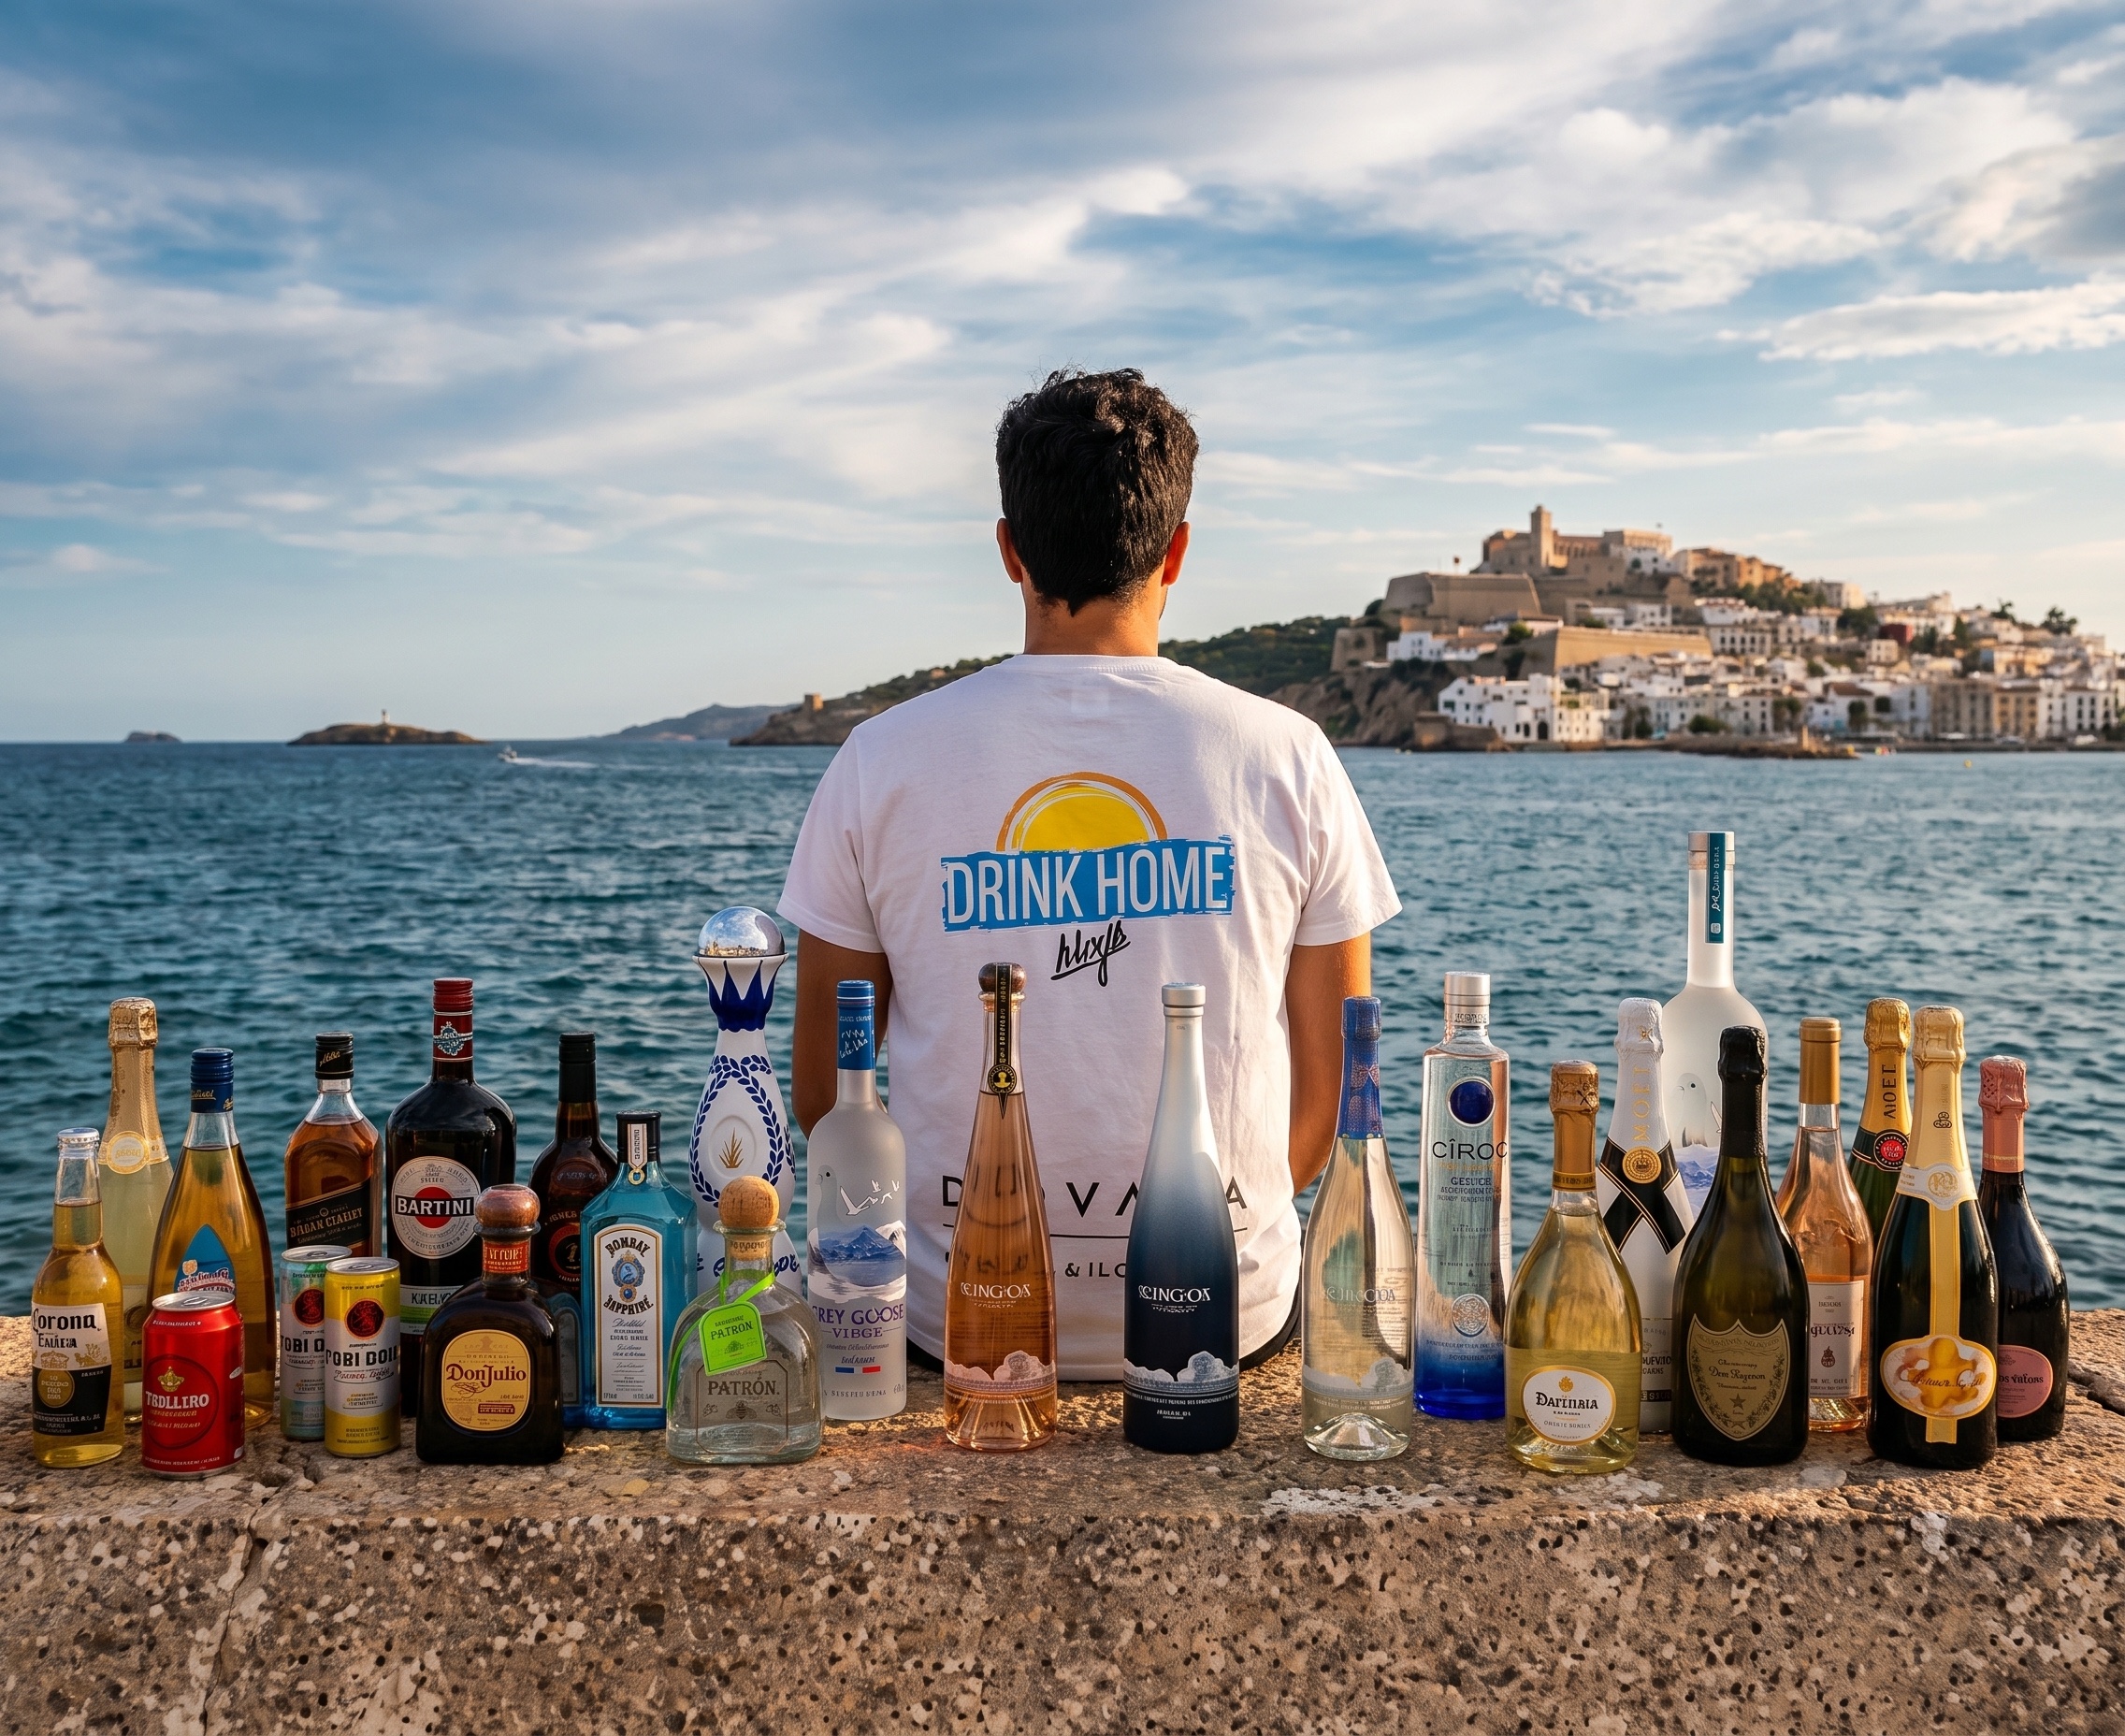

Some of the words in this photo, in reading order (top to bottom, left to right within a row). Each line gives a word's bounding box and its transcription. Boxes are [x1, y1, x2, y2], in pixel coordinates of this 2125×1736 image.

[947, 855, 1083, 924] DRINK
[1098, 846, 1227, 916] HOME
[1433, 1138, 1507, 1160] CÎROC
[398, 1198, 470, 1215] BARTINI
[33, 1309, 97, 1335] Corona
[851, 1304, 903, 1324] GOOSE
